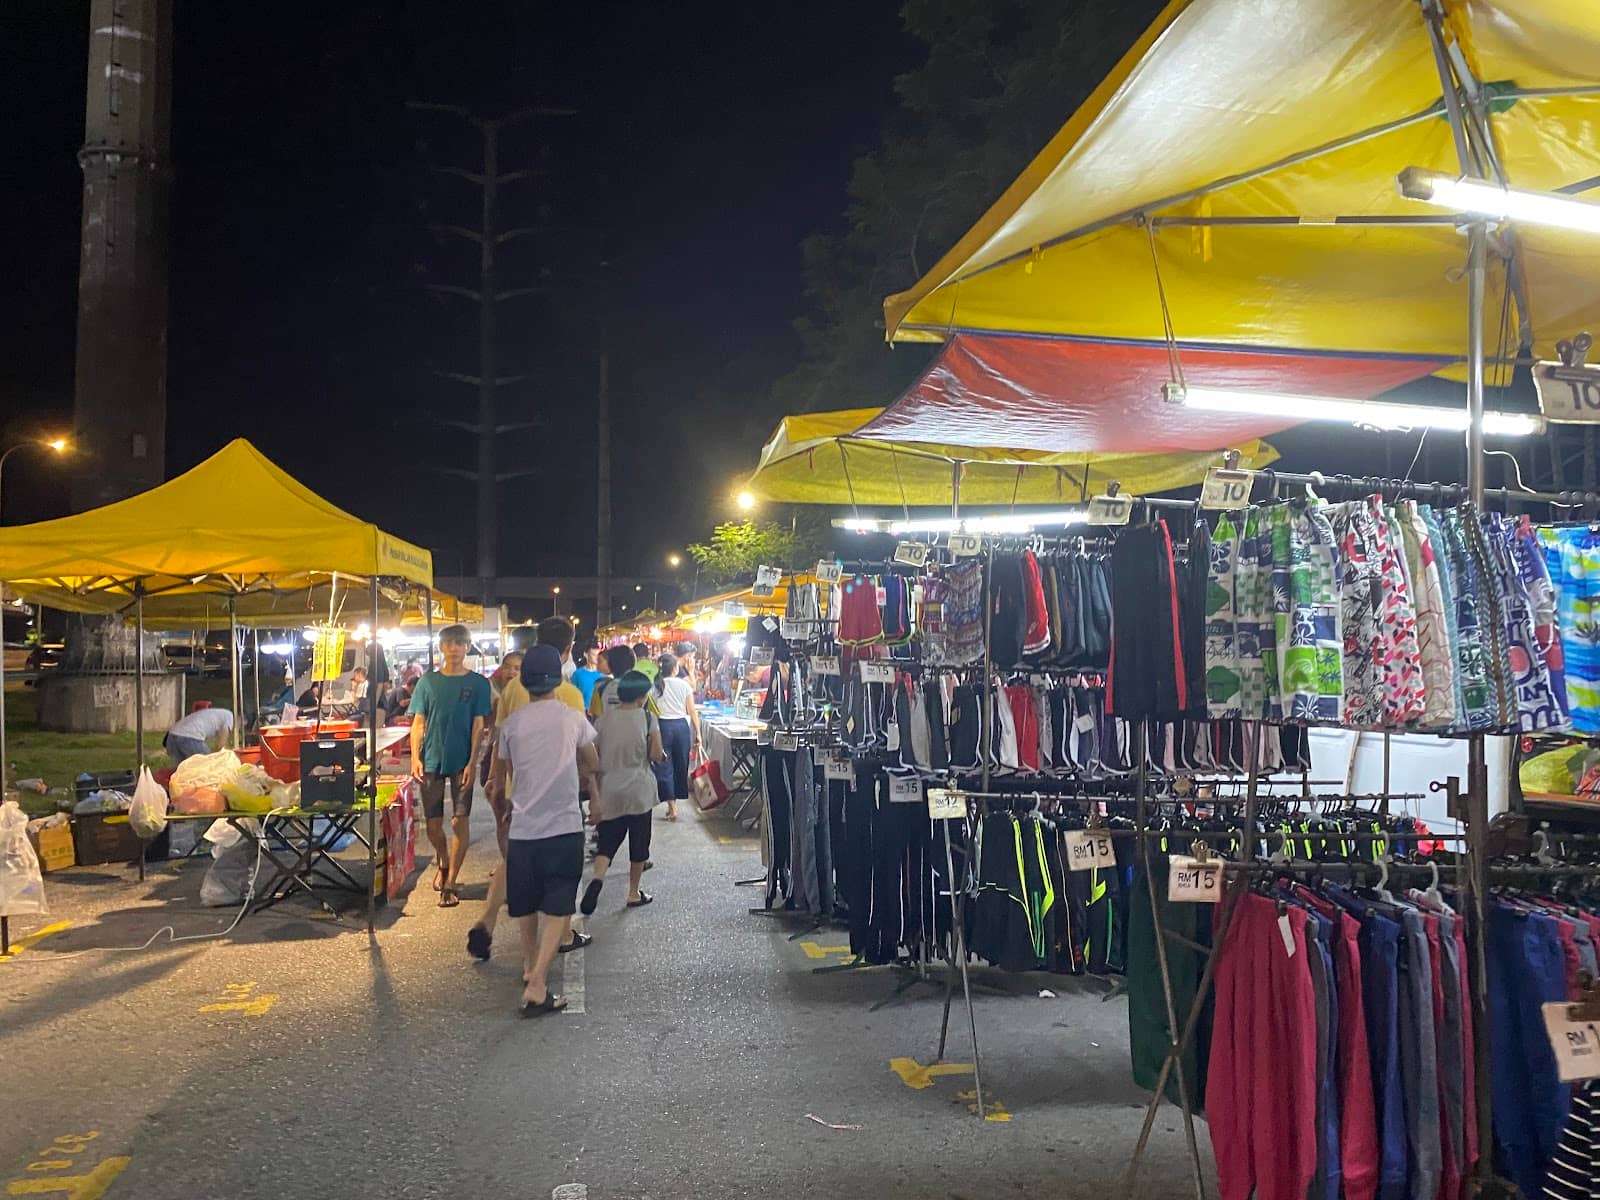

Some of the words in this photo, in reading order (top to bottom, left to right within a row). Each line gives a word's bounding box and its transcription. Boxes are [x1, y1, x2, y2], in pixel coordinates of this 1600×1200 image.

[1223, 482, 1246, 501] 10
[1105, 504, 1125, 518] 10
[962, 539, 976, 550] 10
[908, 548, 922, 560] 10
[826, 567, 838, 577] 10
